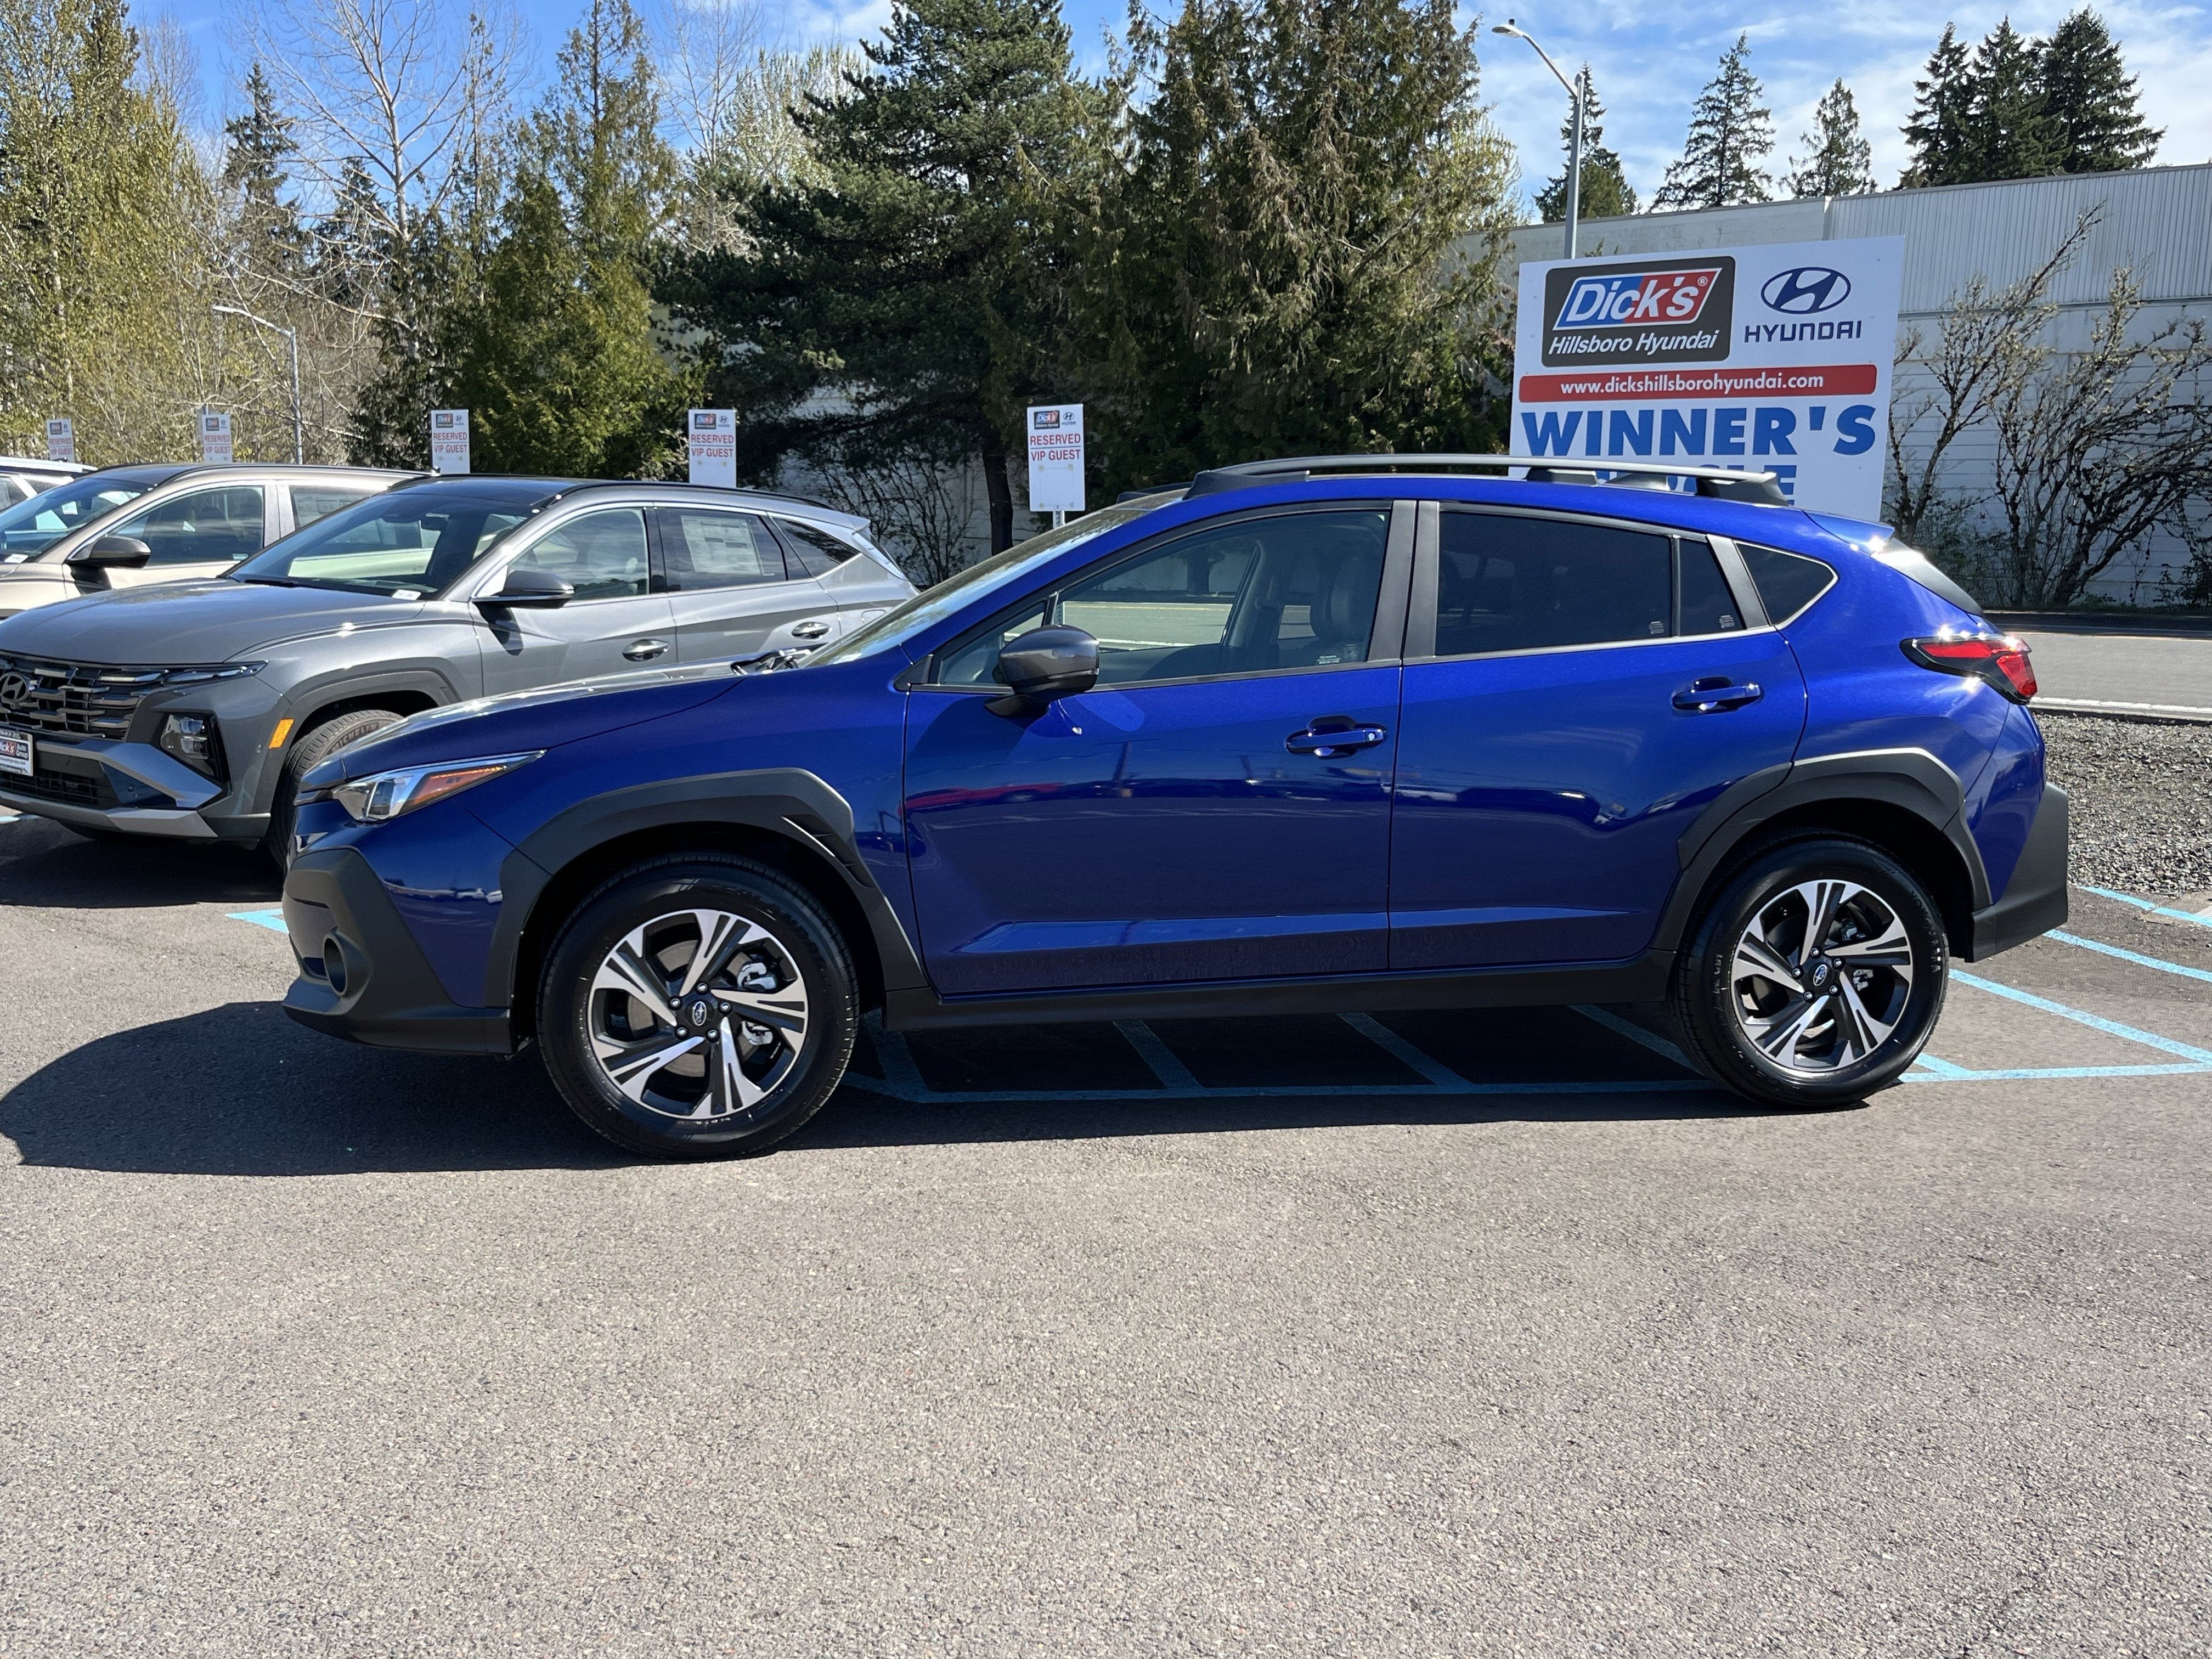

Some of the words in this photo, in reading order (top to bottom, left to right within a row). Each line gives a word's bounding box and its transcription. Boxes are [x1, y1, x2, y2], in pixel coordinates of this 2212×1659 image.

[1566, 276, 1699, 323] Dick's
[1744, 320, 1862, 343] HYUNDAI
[1549, 335, 1633, 356] Hillsboro
[1635, 330, 1718, 355] Hyundai
[1560, 373, 1824, 395] www.dickshillsborohyundai.com
[1521, 404, 1876, 456] WINNER'S
[432, 432, 467, 441] RESERVED
[691, 434, 733, 443] RESERVED
[1030, 433, 1081, 445] RESERVED
[434, 445, 444, 453] VIP
[446, 444, 467, 453] GUEST
[691, 448, 704, 457] VIP
[706, 448, 733, 458] GUEST
[1031, 451, 1046, 461] VIP
[1048, 449, 1081, 460] GUEST
